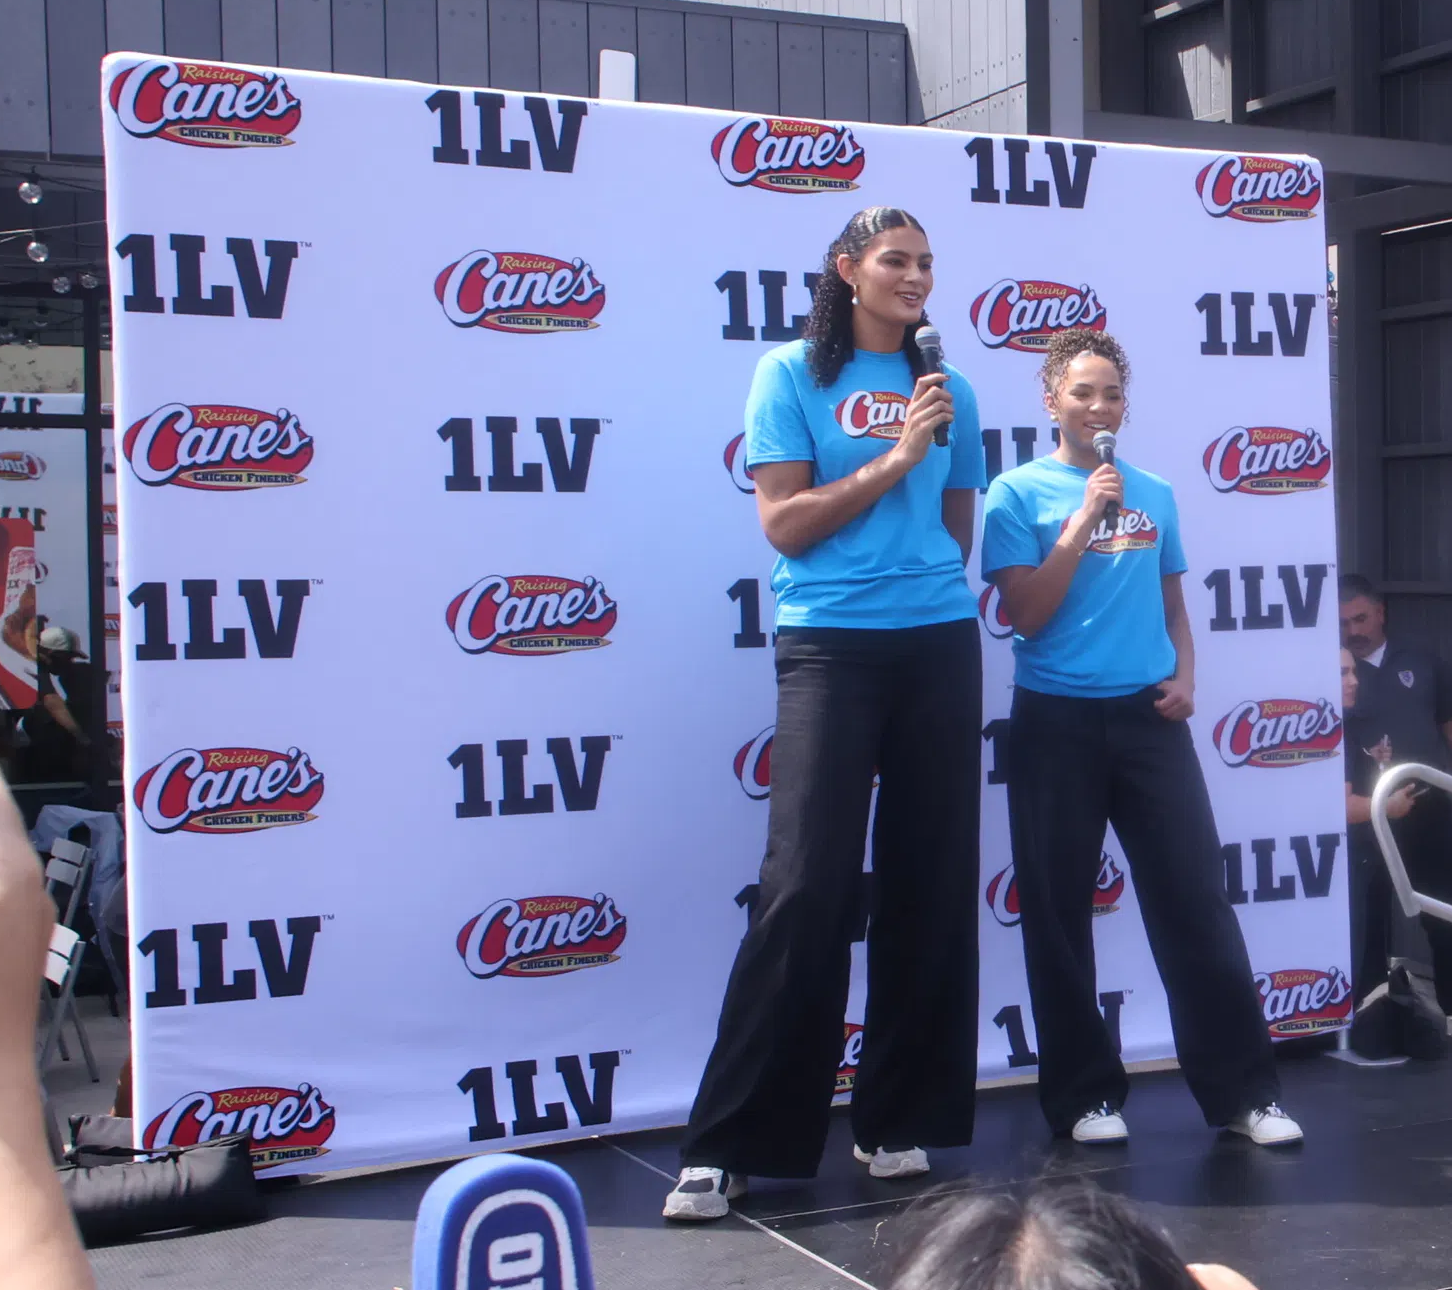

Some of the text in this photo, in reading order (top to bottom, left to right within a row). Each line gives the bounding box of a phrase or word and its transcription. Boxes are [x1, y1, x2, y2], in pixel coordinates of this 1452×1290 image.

[117, 61, 301, 136] Cane's
[183, 65, 245, 84] Raising
[425, 90, 587, 173] 1LV
[719, 116, 862, 183] Cane's
[771, 120, 820, 136] Raising
[964, 138, 1096, 208] 1LV
[1202, 154, 1318, 214] Cane's
[116, 234, 298, 319] 1LV
[443, 250, 605, 326] Cane's
[501, 255, 555, 273] Raising
[1023, 284, 1067, 298] Raising
[977, 279, 1105, 345] Cane's
[1195, 292, 1315, 356] 1LV
[131, 403, 313, 485] Cane's
[197, 408, 258, 426] Raising
[841, 390, 908, 437] Can
[1253, 430, 1293, 443] Raising
[437, 417, 600, 492] 1LV
[1210, 426, 1328, 489] Cane's
[454, 575, 617, 654] Cane's
[513, 578, 567, 594] Raising
[1204, 565, 1327, 631] 1LV
[128, 580, 309, 660] 1LV
[208, 752, 268, 769] Raising
[1220, 697, 1342, 765] Cane's
[142, 747, 323, 831] Cane's
[447, 736, 611, 818] 1LV
[466, 893, 625, 978] Cane's
[524, 898, 578, 915] Raising
[138, 916, 321, 1008] 1LV
[1275, 973, 1316, 987] Raising
[218, 1090, 279, 1108] Raising
[457, 1051, 620, 1141] 1LV
